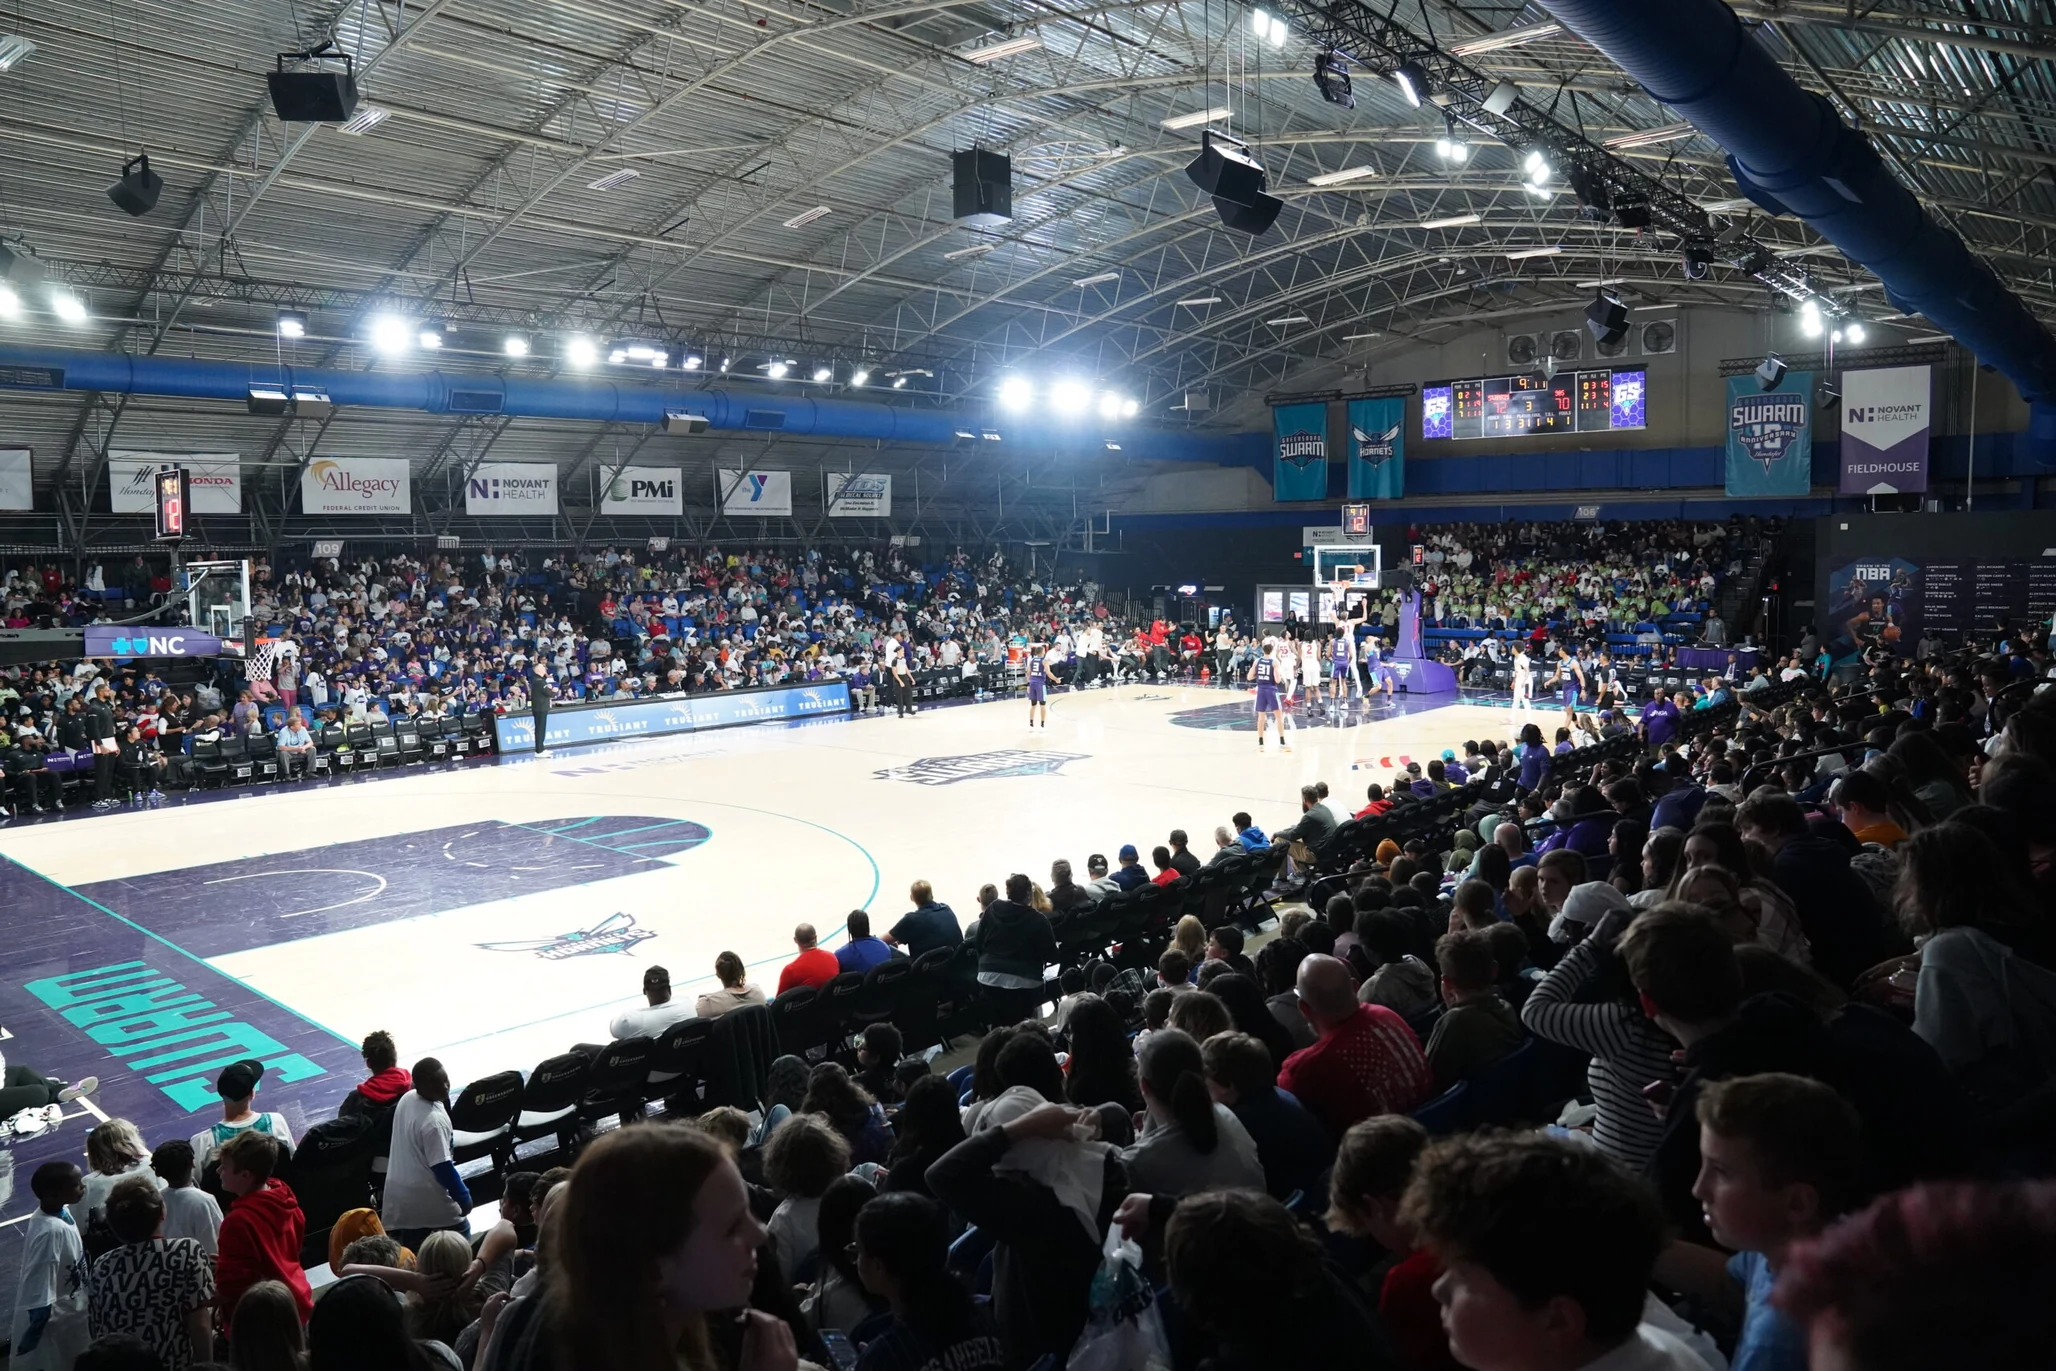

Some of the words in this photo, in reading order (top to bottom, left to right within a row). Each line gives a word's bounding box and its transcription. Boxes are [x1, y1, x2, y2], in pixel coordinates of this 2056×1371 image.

[1519, 378, 1546, 390] 9:11
[1583, 382, 1589, 390] 0
[1458, 392, 1463, 400] 0
[1583, 392, 1589, 400] 2
[1459, 401, 1464, 409] 3
[1493, 402, 1508, 414] 72
[1526, 401, 1532, 412] 3
[1555, 397, 1570, 410] 70
[1878, 404, 1921, 413] NOVANT
[1733, 404, 1805, 427] SWARM
[1877, 412, 1917, 422] HEALTH
[1505, 420, 1511, 430] 3
[1546, 417, 1553, 426] 4
[1282, 435, 1321, 443] GREENSBORO
[1740, 430, 1796, 443] ANNIVERSARY
[1280, 442, 1324, 459] SWARM
[1360, 446, 1393, 457] HORNETS
[1848, 462, 1920, 474] FIELDHOUSE
[322, 471, 400, 499] Allegacy
[503, 479, 549, 489] NOVANT
[631, 480, 673, 498] PMi
[503, 490, 546, 499] HEALTH
[1579, 508, 1596, 516] 106
[1353, 517, 1364, 532] 12
[316, 544, 340, 554] 109
[1856, 568, 1890, 580] NBA
[150, 637, 185, 654] NC
[1280, 645, 1288, 654] 55
[1307, 645, 1313, 655] 2
[1338, 642, 1344, 652] 0
[1032, 662, 1039, 671] 3
[1258, 664, 1270, 675] 31
[799, 698, 845, 710] TRULIANT
[734, 705, 785, 718] TRULIANT
[665, 712, 719, 726] TRULIANT
[588, 720, 648, 735] TRULIANT
[505, 729, 571, 745] TRUANT
[23, 960, 328, 1113] SWARM
